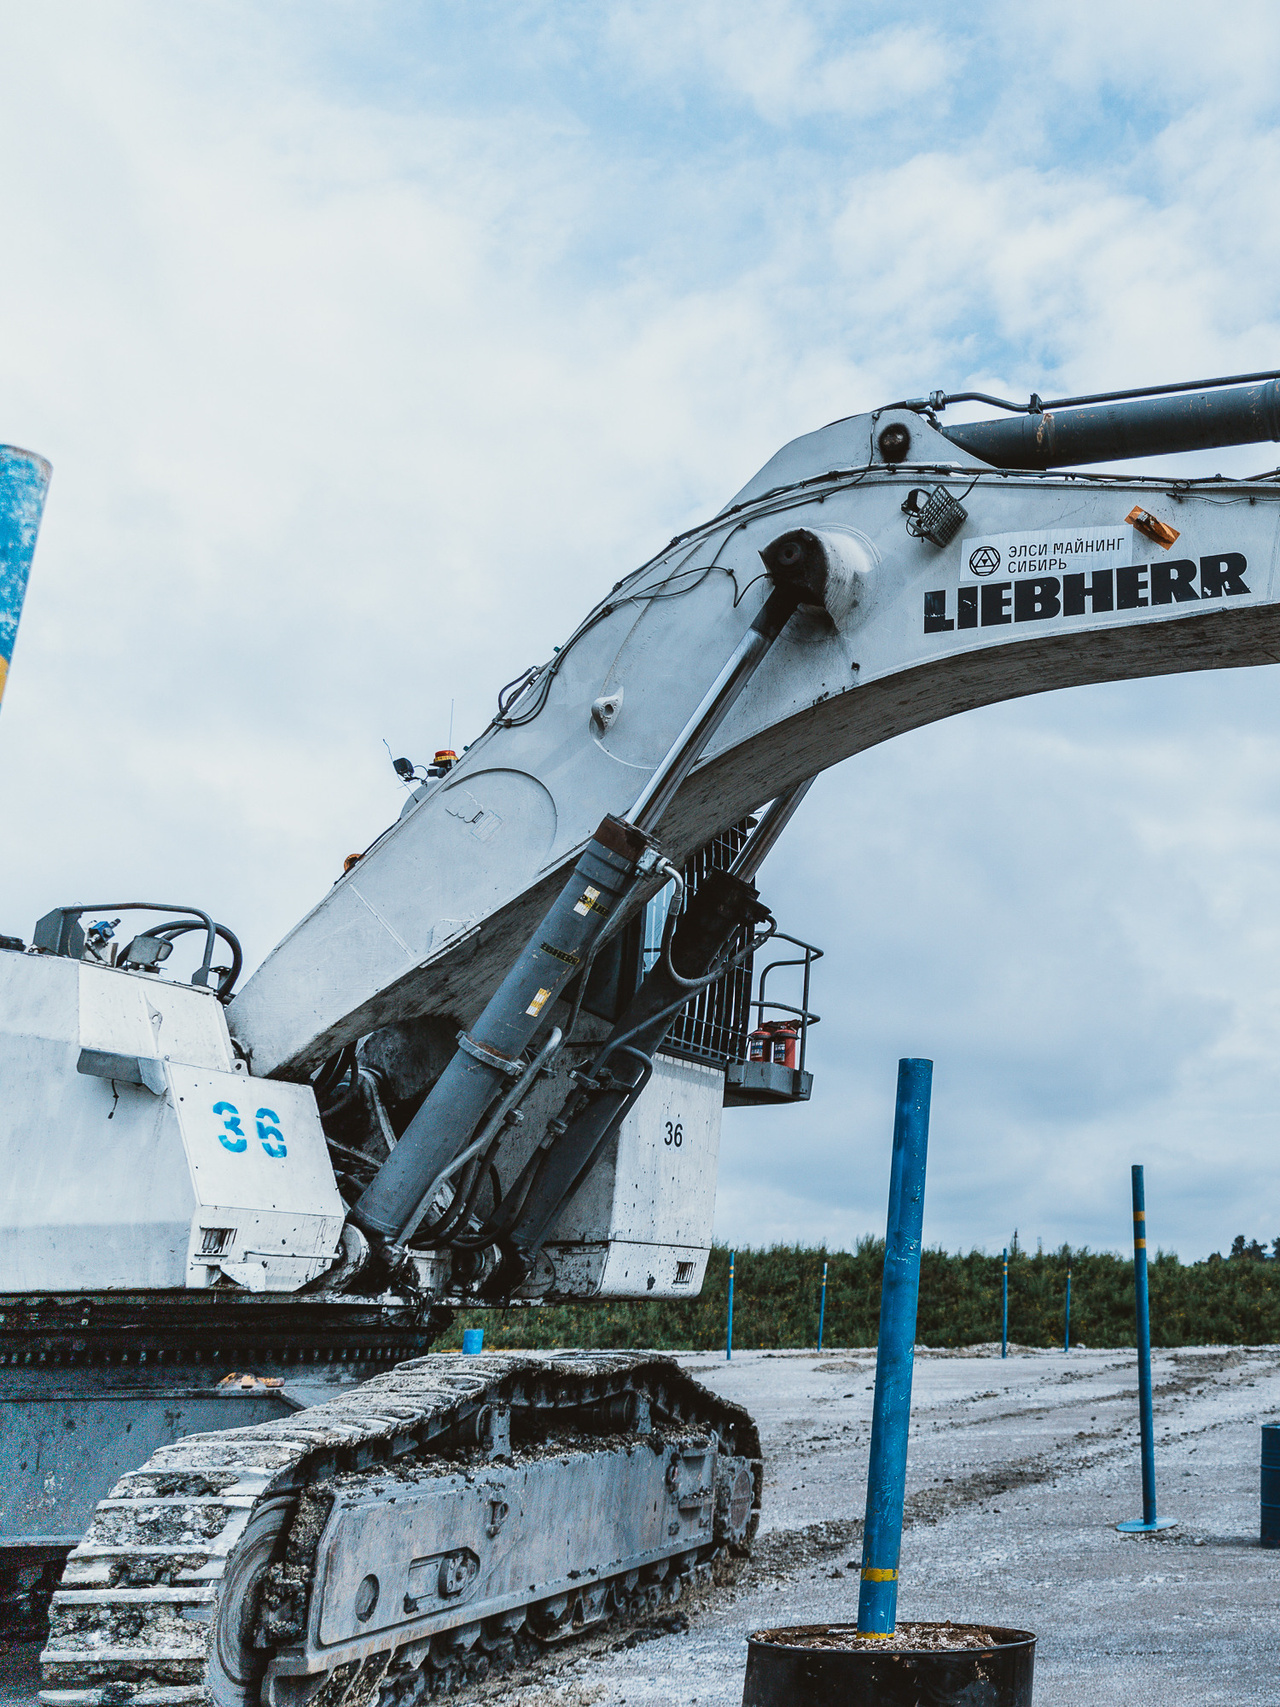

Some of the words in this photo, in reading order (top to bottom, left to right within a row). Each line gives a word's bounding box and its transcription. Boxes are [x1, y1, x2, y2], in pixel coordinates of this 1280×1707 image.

[1008, 543, 1048, 558] ЭЛСИ
[1053, 537, 1125, 555] МАЙНИНГ
[1008, 558, 1067, 573] СИБИРЬ
[923, 552, 1252, 634] LIEBHERR
[212, 1101, 288, 1158] 36
[664, 1121, 683, 1148] 36
